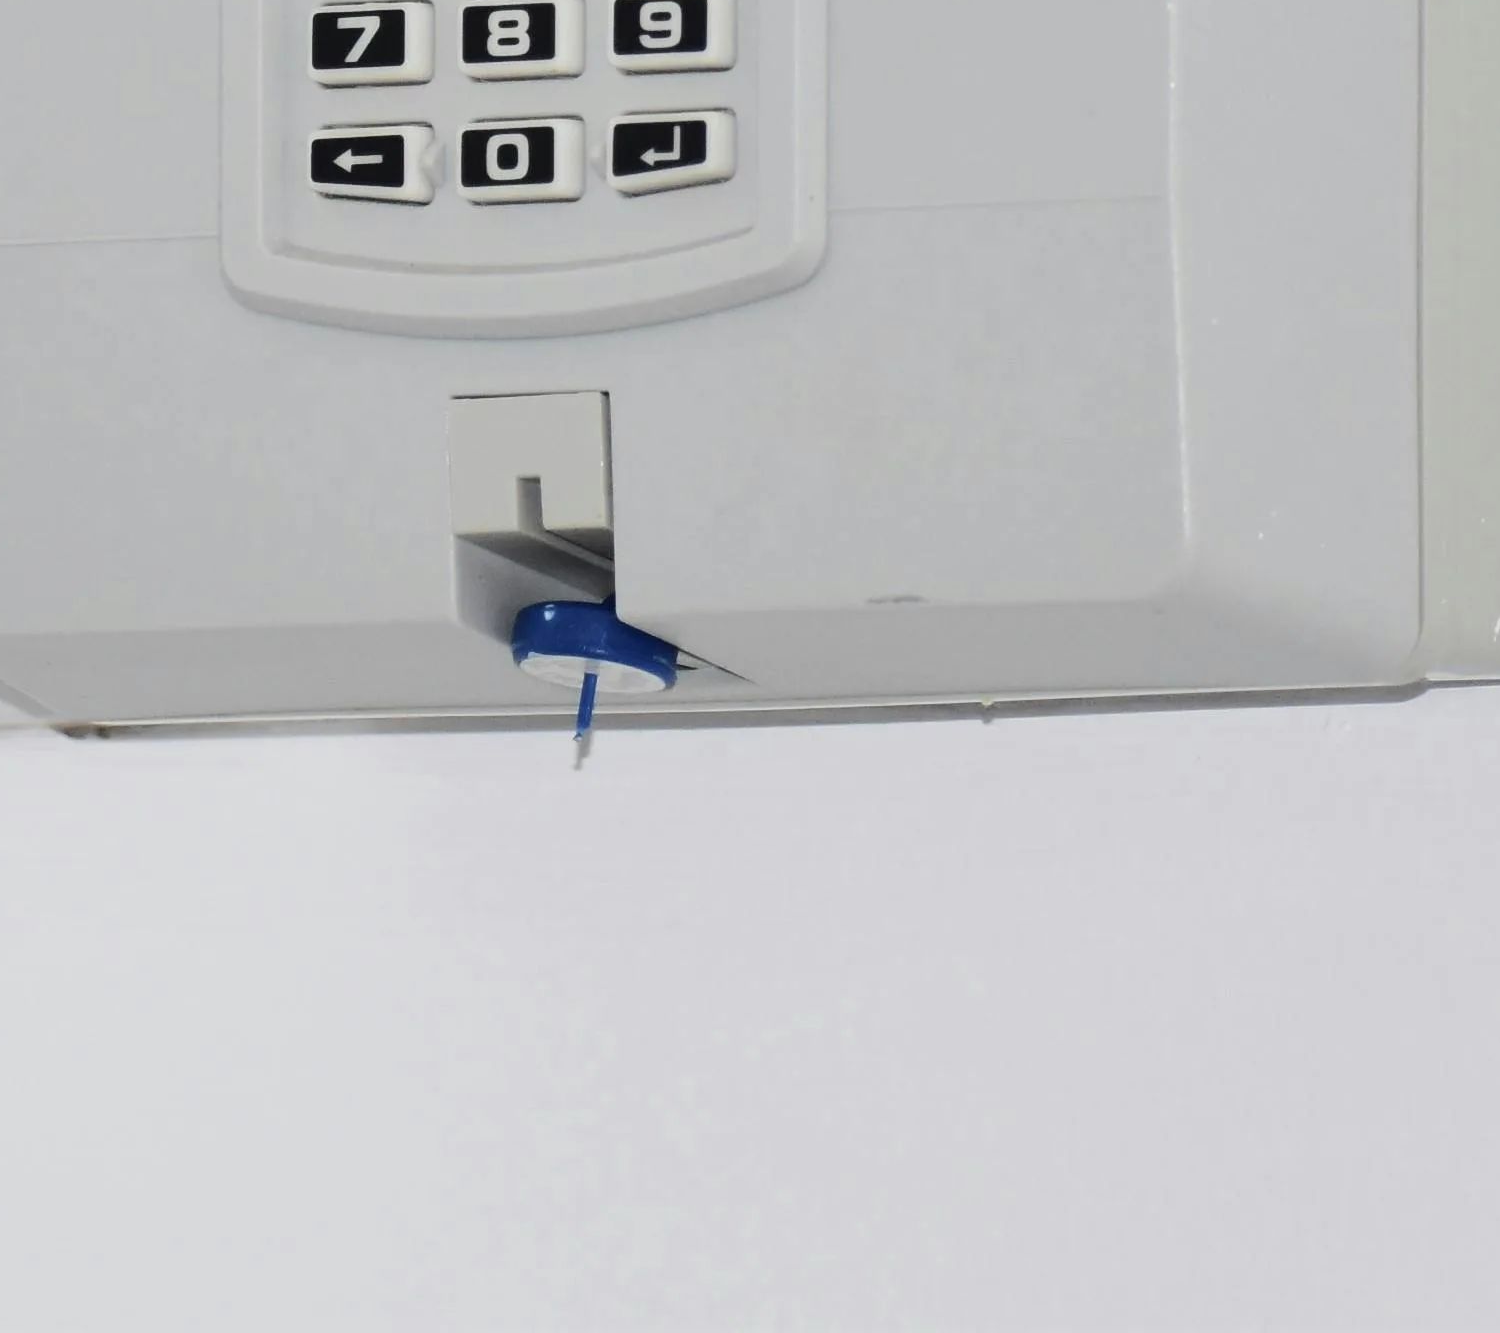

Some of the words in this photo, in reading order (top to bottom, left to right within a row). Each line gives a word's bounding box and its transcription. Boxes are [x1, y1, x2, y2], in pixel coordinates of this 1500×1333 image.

[336, 15, 381, 63] 7
[487, 9, 531, 57] 8
[639, 0, 683, 49] 9
[486, 132, 530, 182] 0
